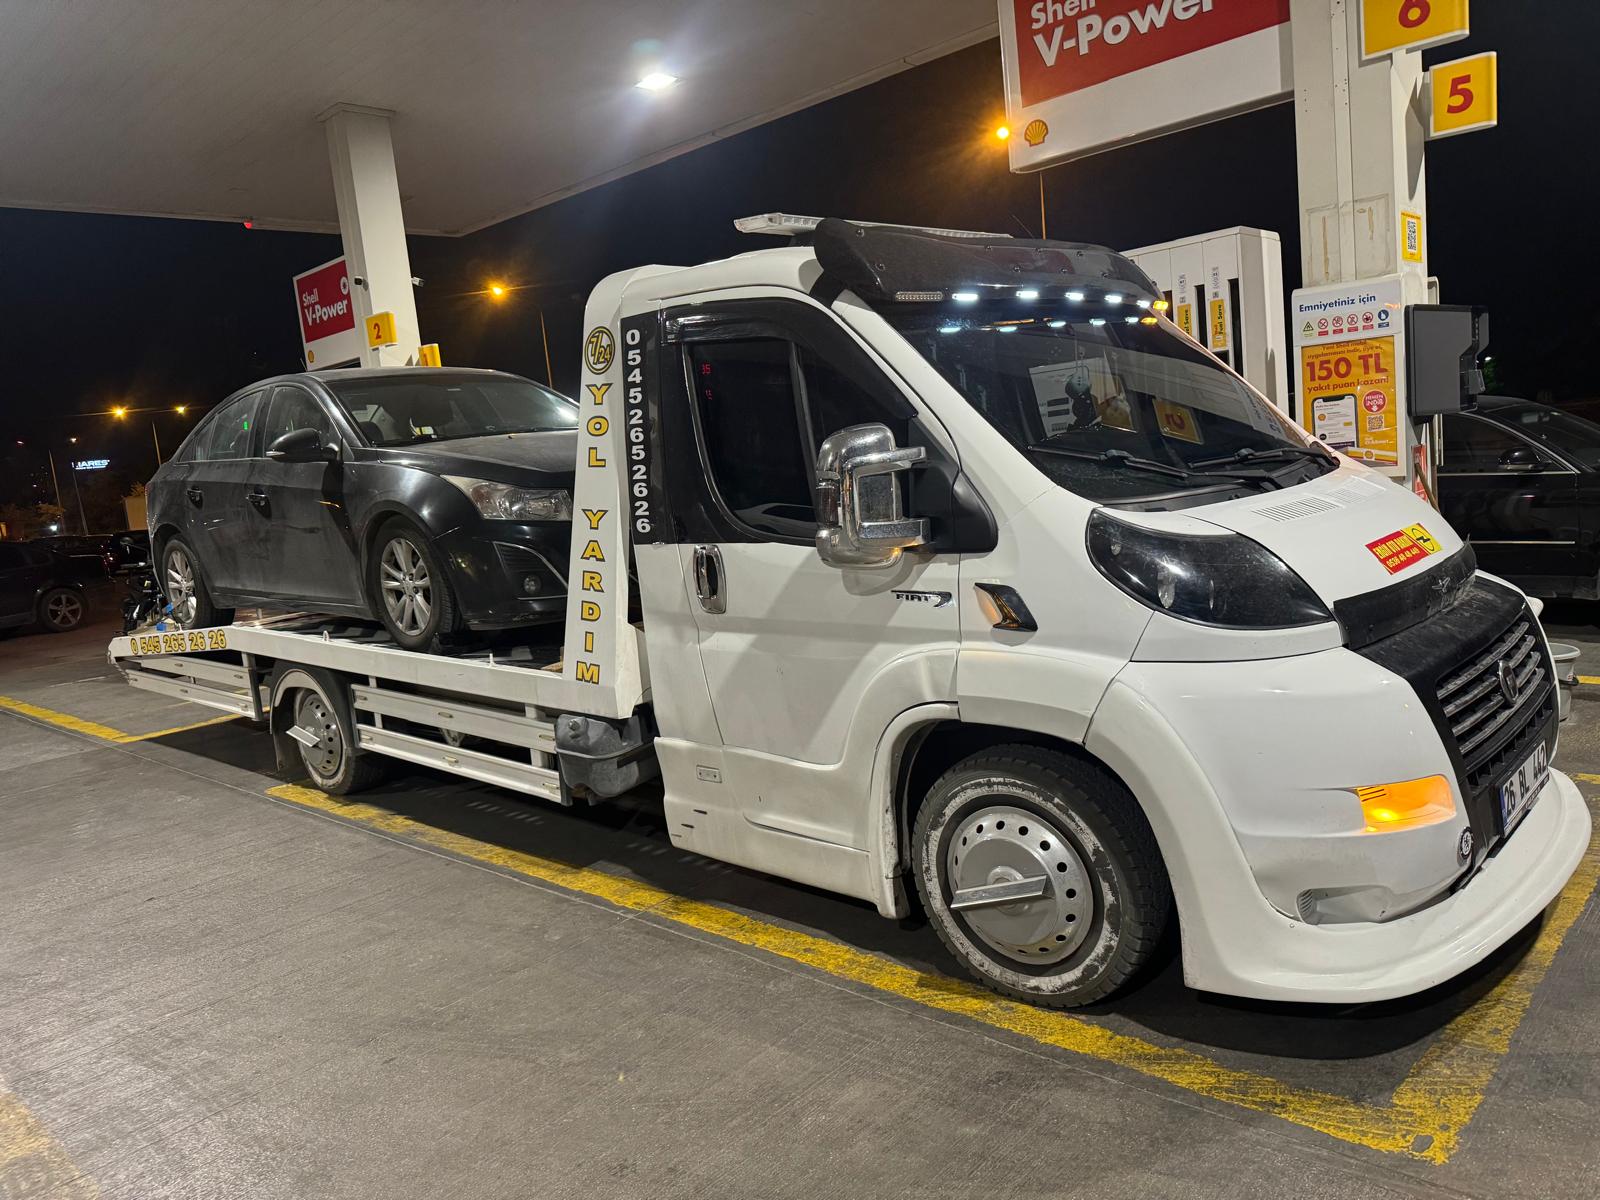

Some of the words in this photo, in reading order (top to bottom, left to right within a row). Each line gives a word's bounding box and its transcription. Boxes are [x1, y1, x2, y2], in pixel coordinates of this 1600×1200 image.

[1398, 0, 1430, 28] 6
[1447, 74, 1474, 114] 5
[302, 288, 319, 307] Shell
[1299, 297, 1355, 312] Emniyetiniz
[1358, 293, 1376, 305] için
[305, 299, 348, 326] V-Power
[373, 322, 382, 340] 2
[1306, 357, 1352, 382] 150
[1358, 353, 1389, 375] TL
[1307, 384, 1330, 394] yakıt
[1332, 381, 1355, 391] puan
[1357, 376, 1389, 386] kazan!
[585, 383, 614, 468] YOL
[626, 329, 651, 532] 05452652626
[576, 509, 608, 684] YARDIM
[131, 638, 138, 655] 0
[140, 636, 161, 654] 545
[163, 633, 186, 652] 265
[188, 632, 206, 651] 26
[208, 629, 227, 649] 26
[1504, 780, 1516, 817] 26
[1518, 766, 1530, 801] BL
[1532, 744, 1547, 781] 442
